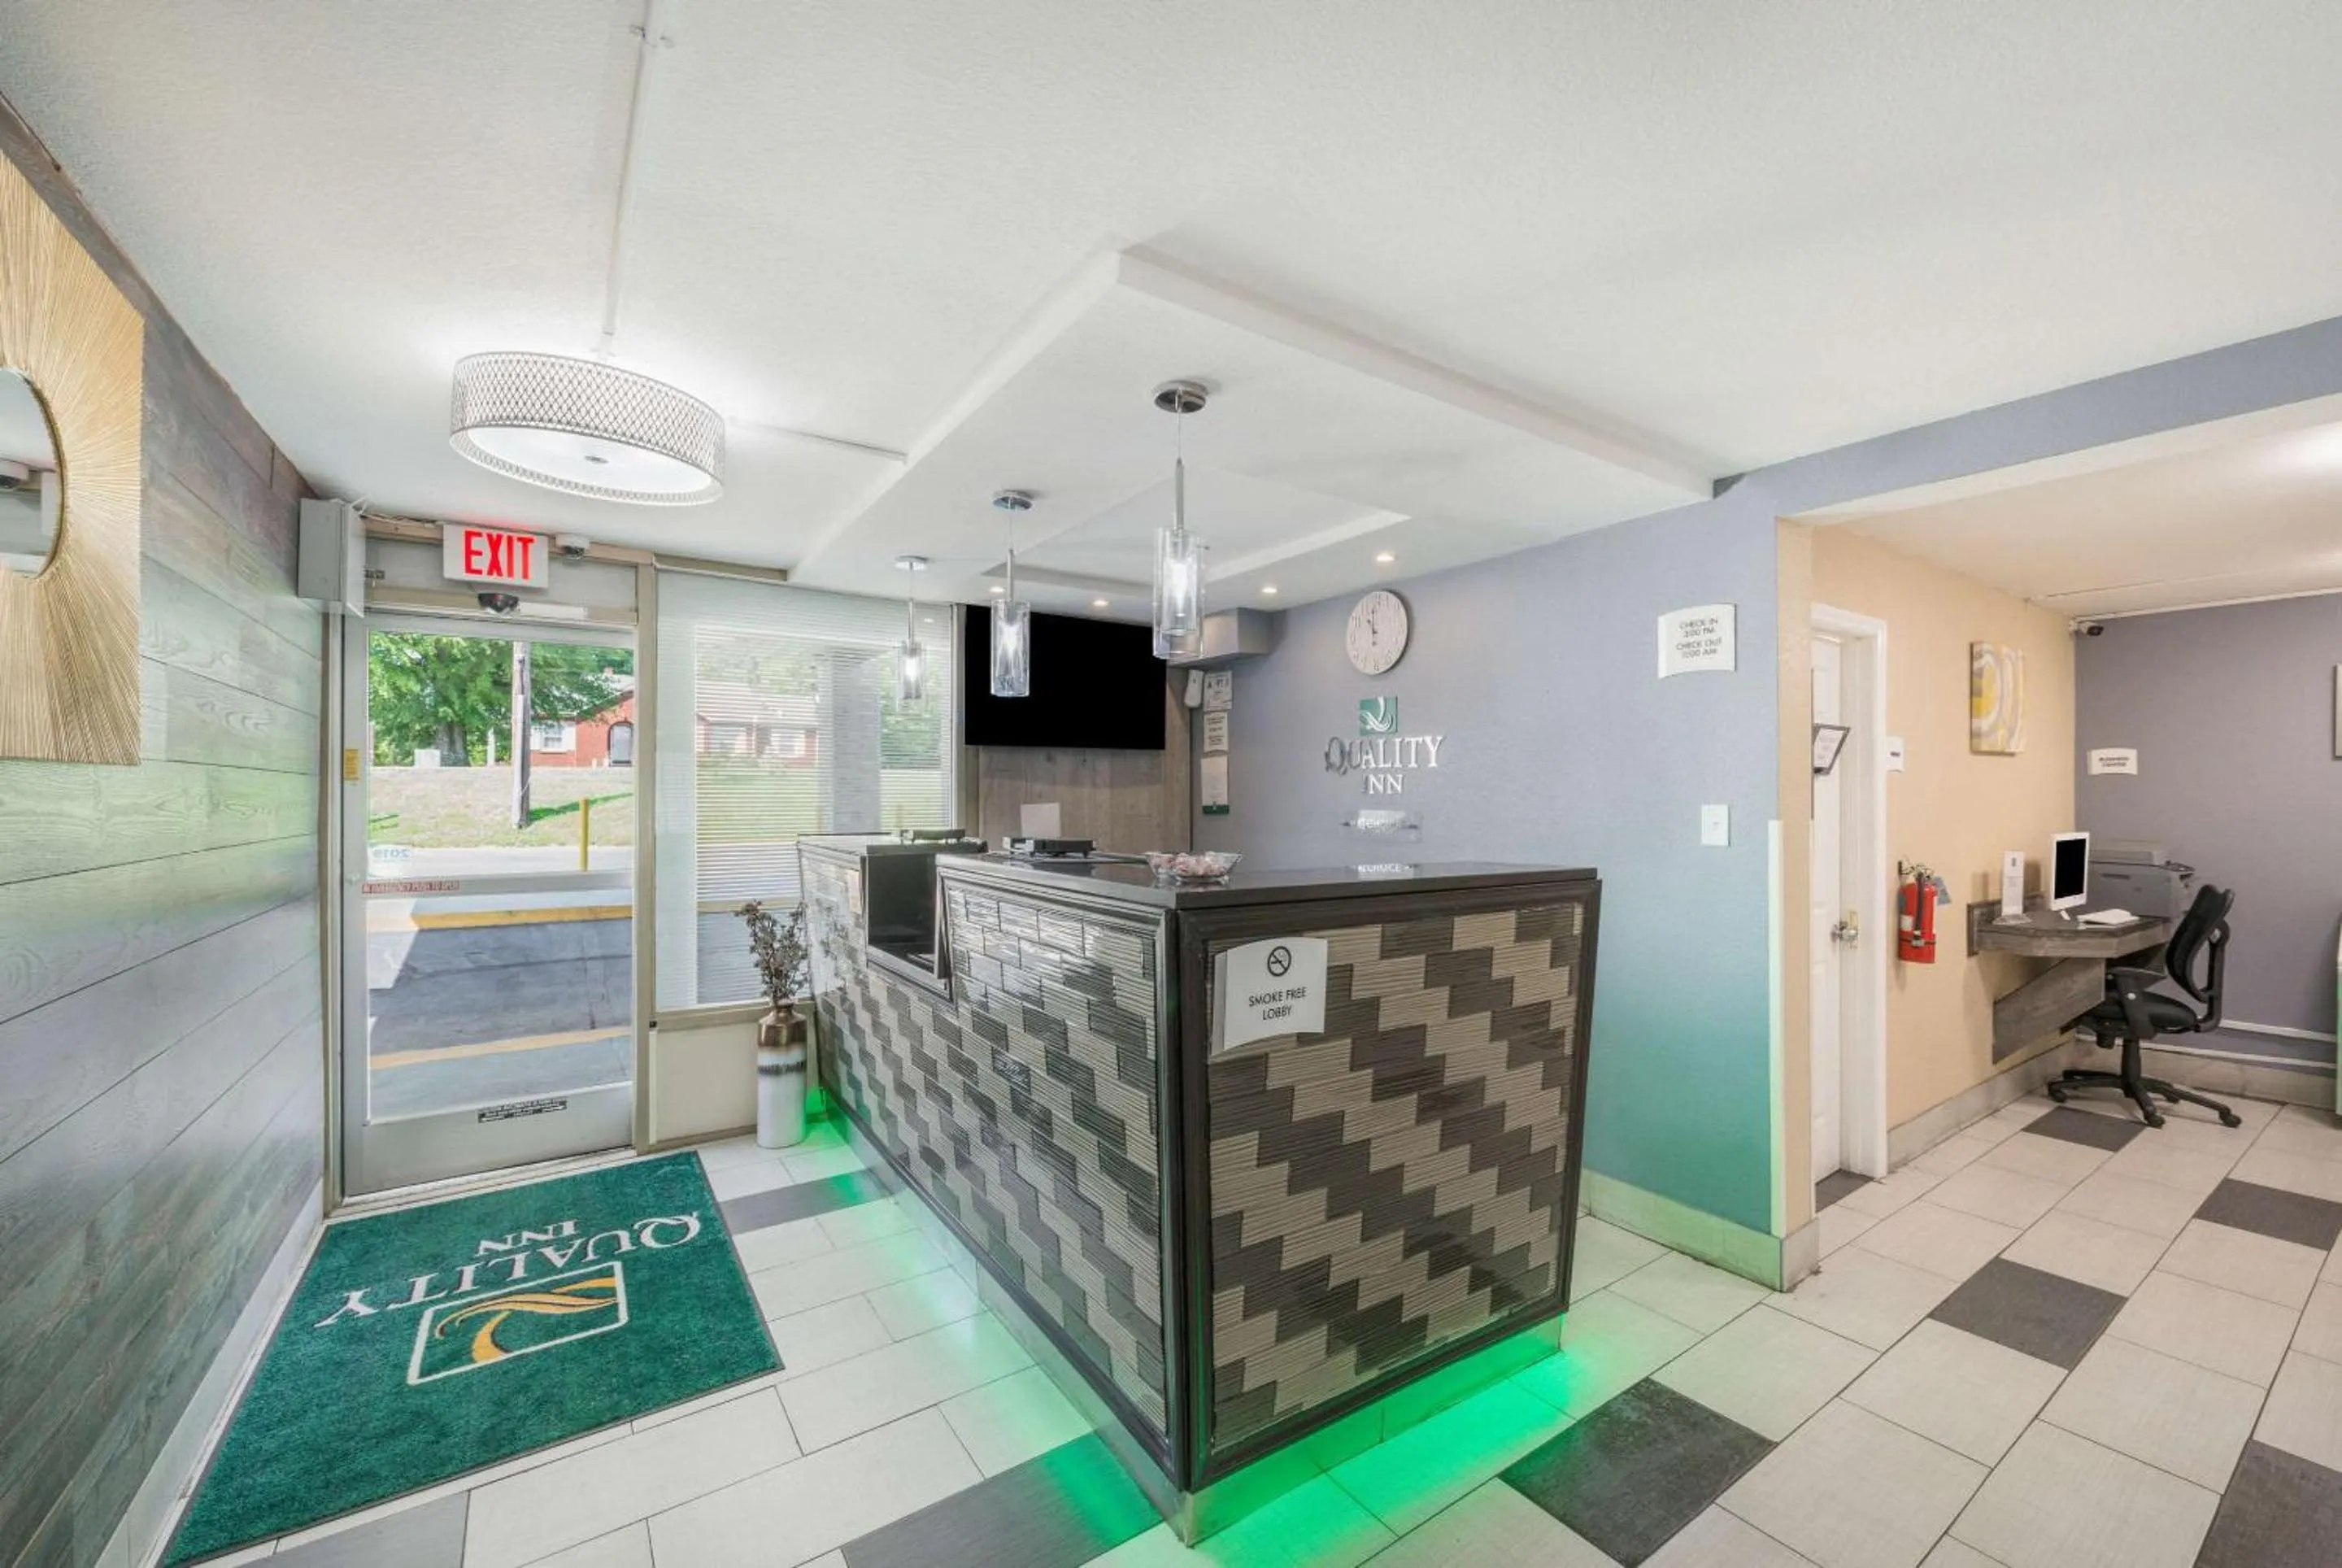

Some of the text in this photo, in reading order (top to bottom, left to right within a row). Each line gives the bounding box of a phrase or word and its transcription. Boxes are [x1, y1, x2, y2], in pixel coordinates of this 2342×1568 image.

[464, 529, 535, 580] EXIT
[1675, 641, 1702, 651] CHECK
[1325, 735, 1446, 777] QUALITY
[1361, 773, 1404, 795] INN
[1248, 987, 1308, 1007] SMOKE FREE
[1262, 1005, 1292, 1021] LOBBY
[474, 1219, 580, 1257] INN
[314, 1211, 702, 1328] QUALITY
